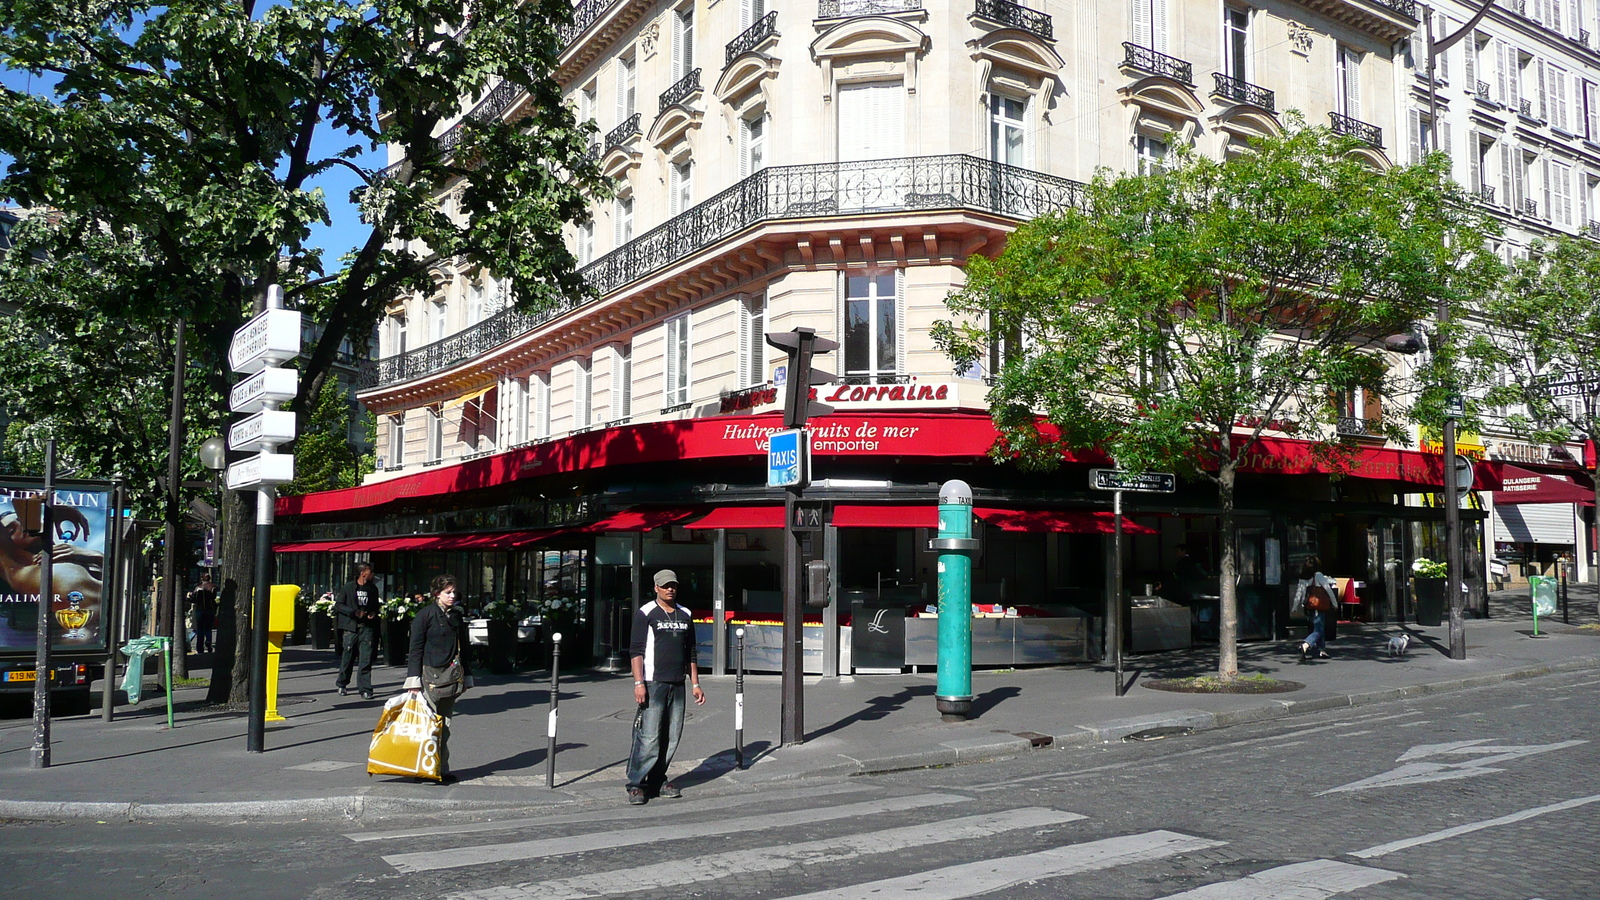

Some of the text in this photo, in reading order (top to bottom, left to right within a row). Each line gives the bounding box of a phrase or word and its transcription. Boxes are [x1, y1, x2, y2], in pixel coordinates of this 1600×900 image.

[825, 376, 949, 402] Lorraine
[722, 423, 783, 439] Huîtres
[855, 421, 877, 439] de
[883, 426, 919, 439] mer
[813, 438, 880, 452] emporter
[771, 449, 796, 467] TAXIS
[9, 671, 25, 680] 419
